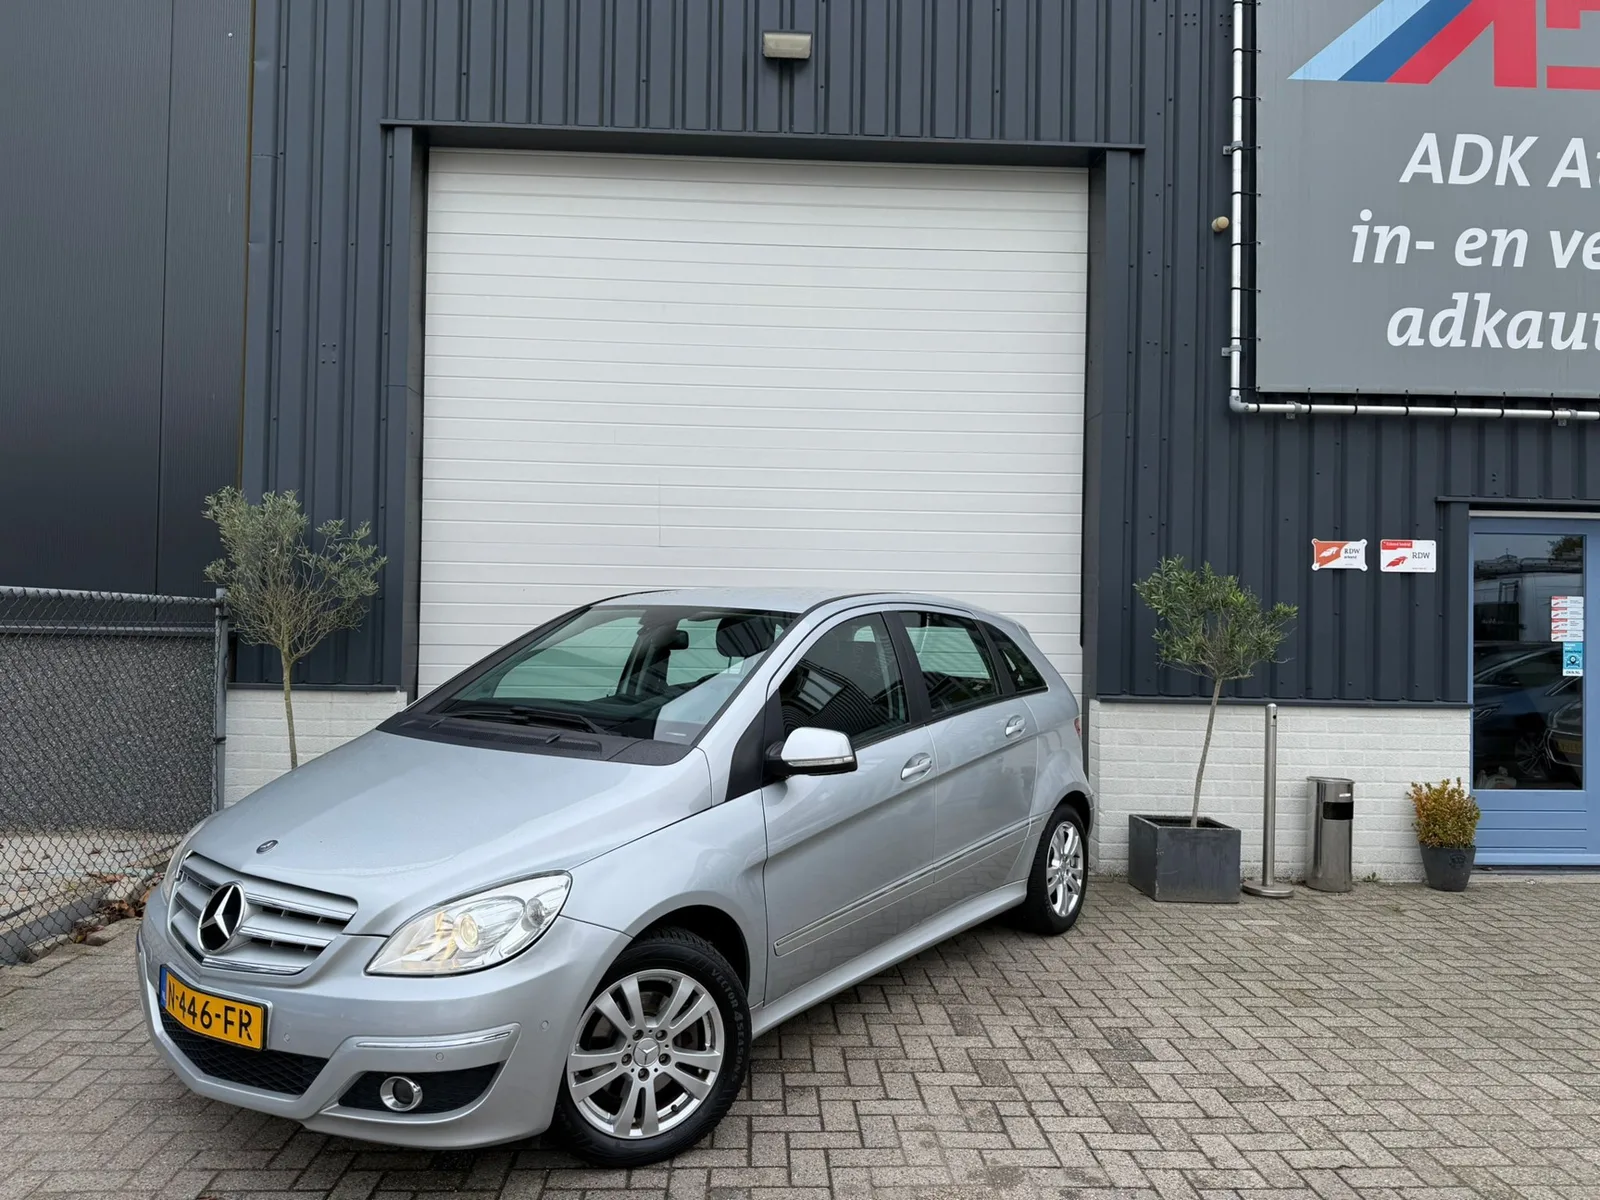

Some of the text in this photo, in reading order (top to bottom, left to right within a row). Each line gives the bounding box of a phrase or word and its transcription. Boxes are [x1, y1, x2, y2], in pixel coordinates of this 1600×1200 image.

[1399, 132, 1600, 189] ADK A
[1351, 209, 1435, 264] in-
[1454, 227, 1528, 268] en
[1386, 292, 1600, 350] adkau
[168, 979, 253, 1042] N-446-FR
[710, 968, 739, 1009] VECTOR
